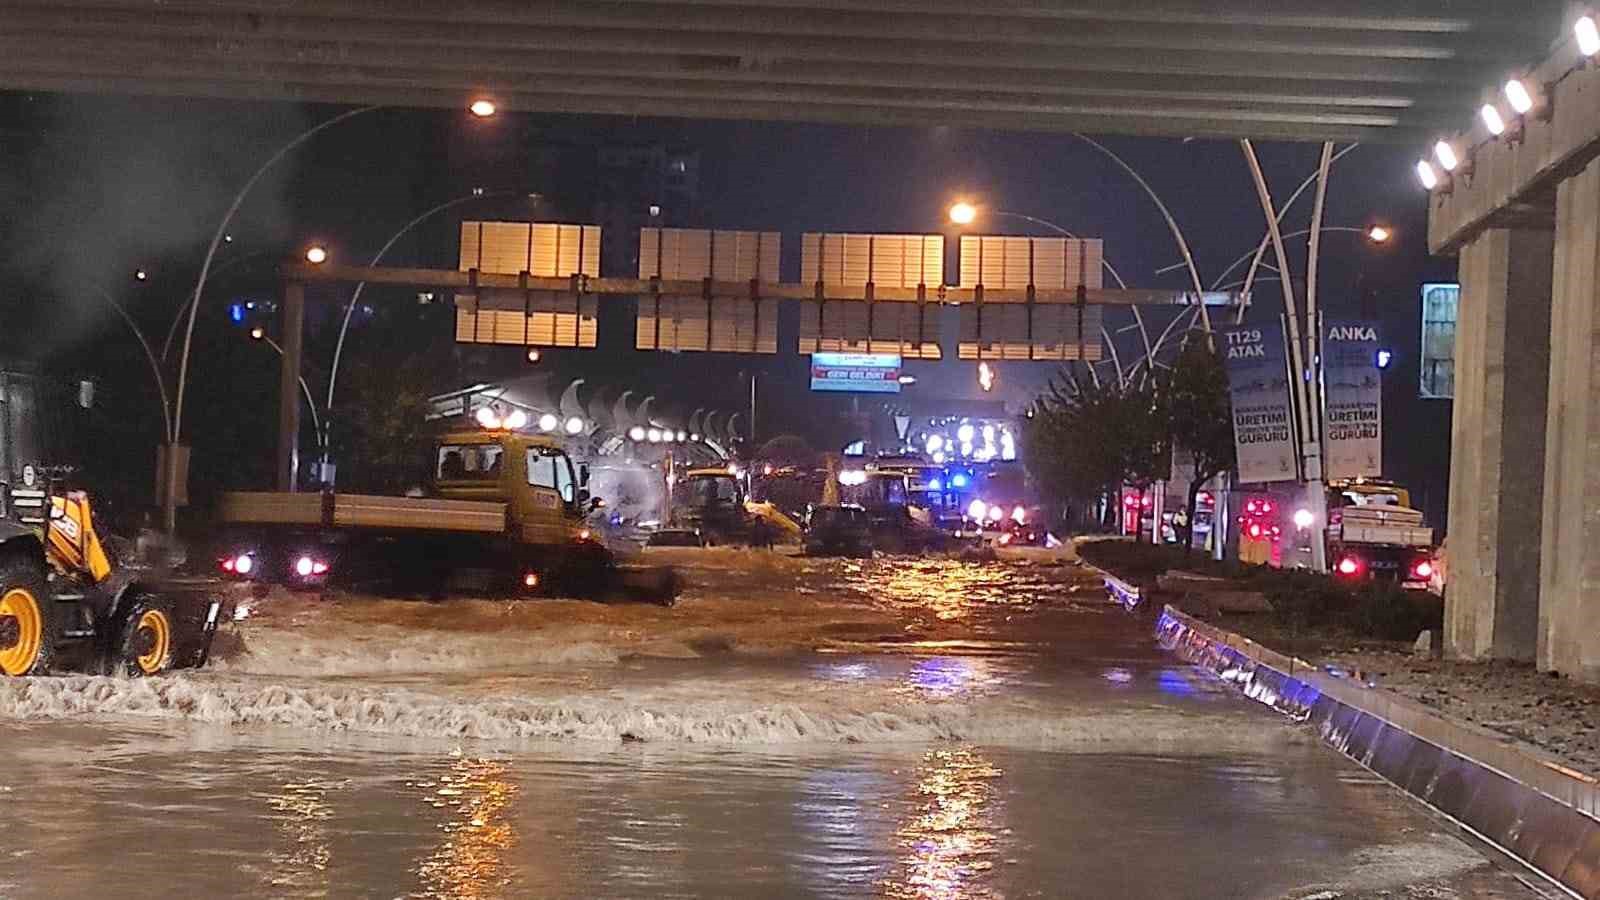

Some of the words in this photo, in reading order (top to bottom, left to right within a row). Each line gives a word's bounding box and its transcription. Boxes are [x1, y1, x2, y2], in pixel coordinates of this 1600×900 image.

[1224, 329, 1261, 344] T129
[1328, 326, 1377, 341] ANKA
[1228, 344, 1264, 358] ATAK
[1238, 430, 1289, 444] GURURU
[1329, 429, 1378, 440] GURURU
